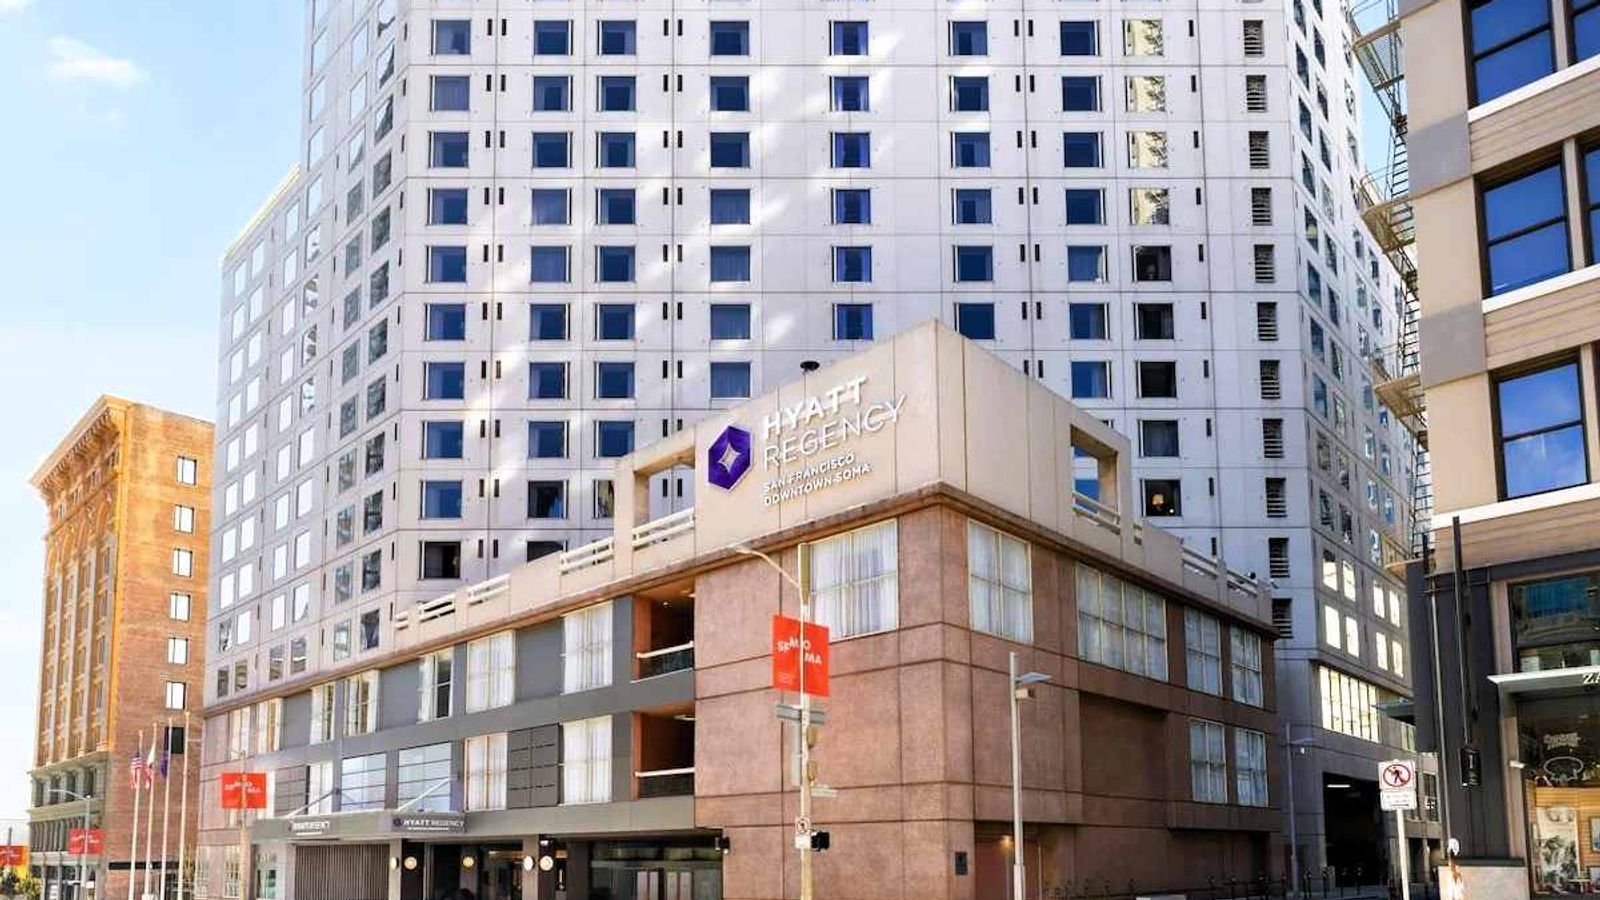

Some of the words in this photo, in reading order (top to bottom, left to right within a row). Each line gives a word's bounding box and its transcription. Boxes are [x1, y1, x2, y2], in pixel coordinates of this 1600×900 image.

[763, 374, 868, 440] HYATT
[763, 394, 907, 471] REGENCY
[762, 476, 785, 493] SAN
[789, 452, 855, 485] FRANCISCO
[763, 476, 832, 506] DOWNTOWN
